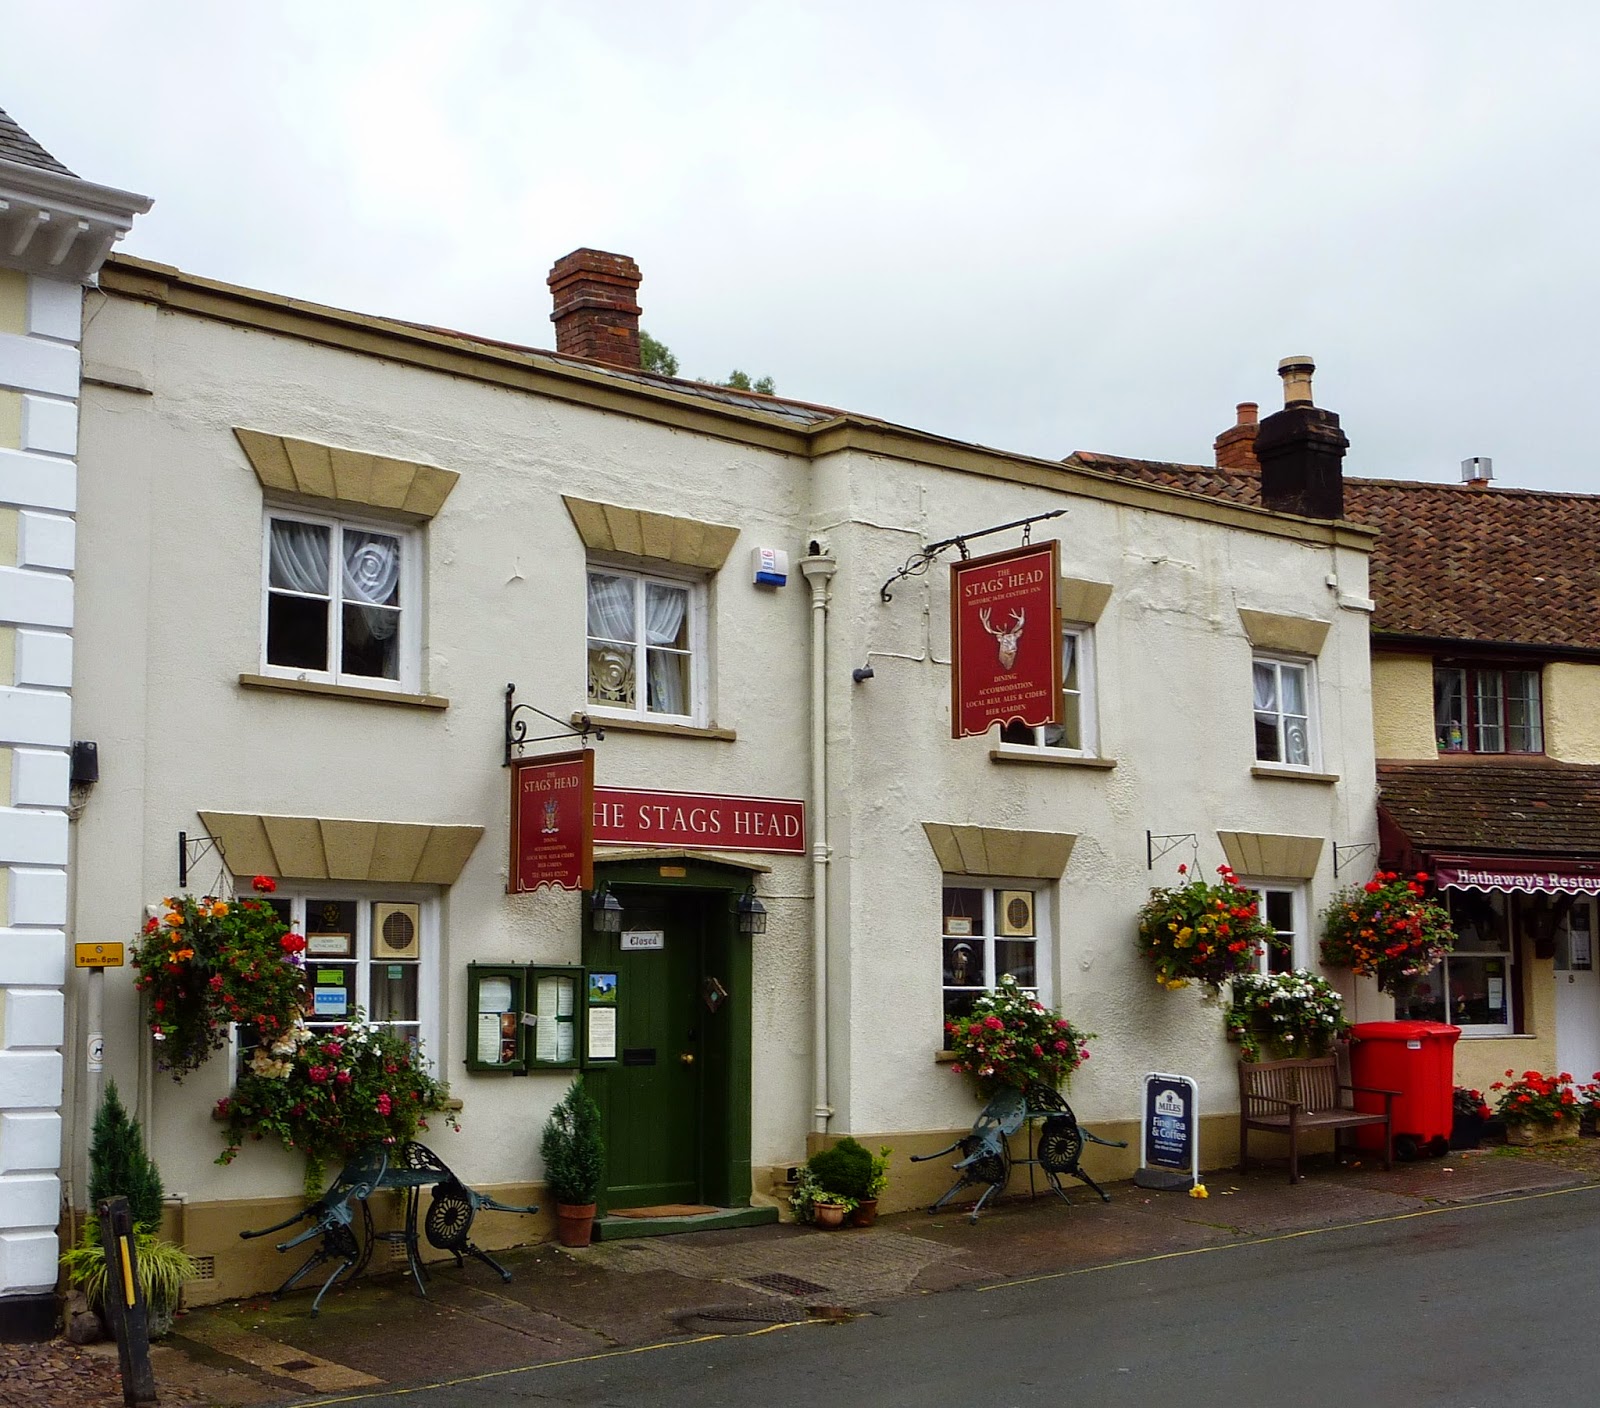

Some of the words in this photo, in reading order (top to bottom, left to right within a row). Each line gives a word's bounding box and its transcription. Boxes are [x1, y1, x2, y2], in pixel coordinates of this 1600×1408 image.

[997, 568, 1010, 577] THE
[965, 578, 1003, 597] STAGS
[1008, 569, 1044, 588] HEAD
[1005, 589, 1029, 598] CENTURY
[993, 673, 1017, 683] DINING
[978, 681, 1034, 695] ACCOMMODATION
[966, 699, 985, 708] LOCAL
[986, 697, 1001, 705] REAL
[1003, 694, 1017, 702] ALES
[1024, 689, 1047, 699] CIDERS
[985, 708, 1000, 716] BEER
[1000, 704, 1026, 714] GARDEN
[546, 771, 556, 779] THE
[524, 779, 551, 793] STAGS
[554, 776, 579, 790] HEAD
[593, 802, 625, 829] HE
[638, 804, 721, 834] STAGS
[734, 811, 800, 838] HEAD
[1457, 869, 1544, 890] Hathaway's
[630, 935, 657, 946] Closed
[1158, 1102, 1181, 1113] MILES
[1153, 1116, 1169, 1128] Fine
[1172, 1119, 1186, 1131] Tea
[1151, 1126, 1159, 1137] &
[1160, 1128, 1187, 1141] Coffee
